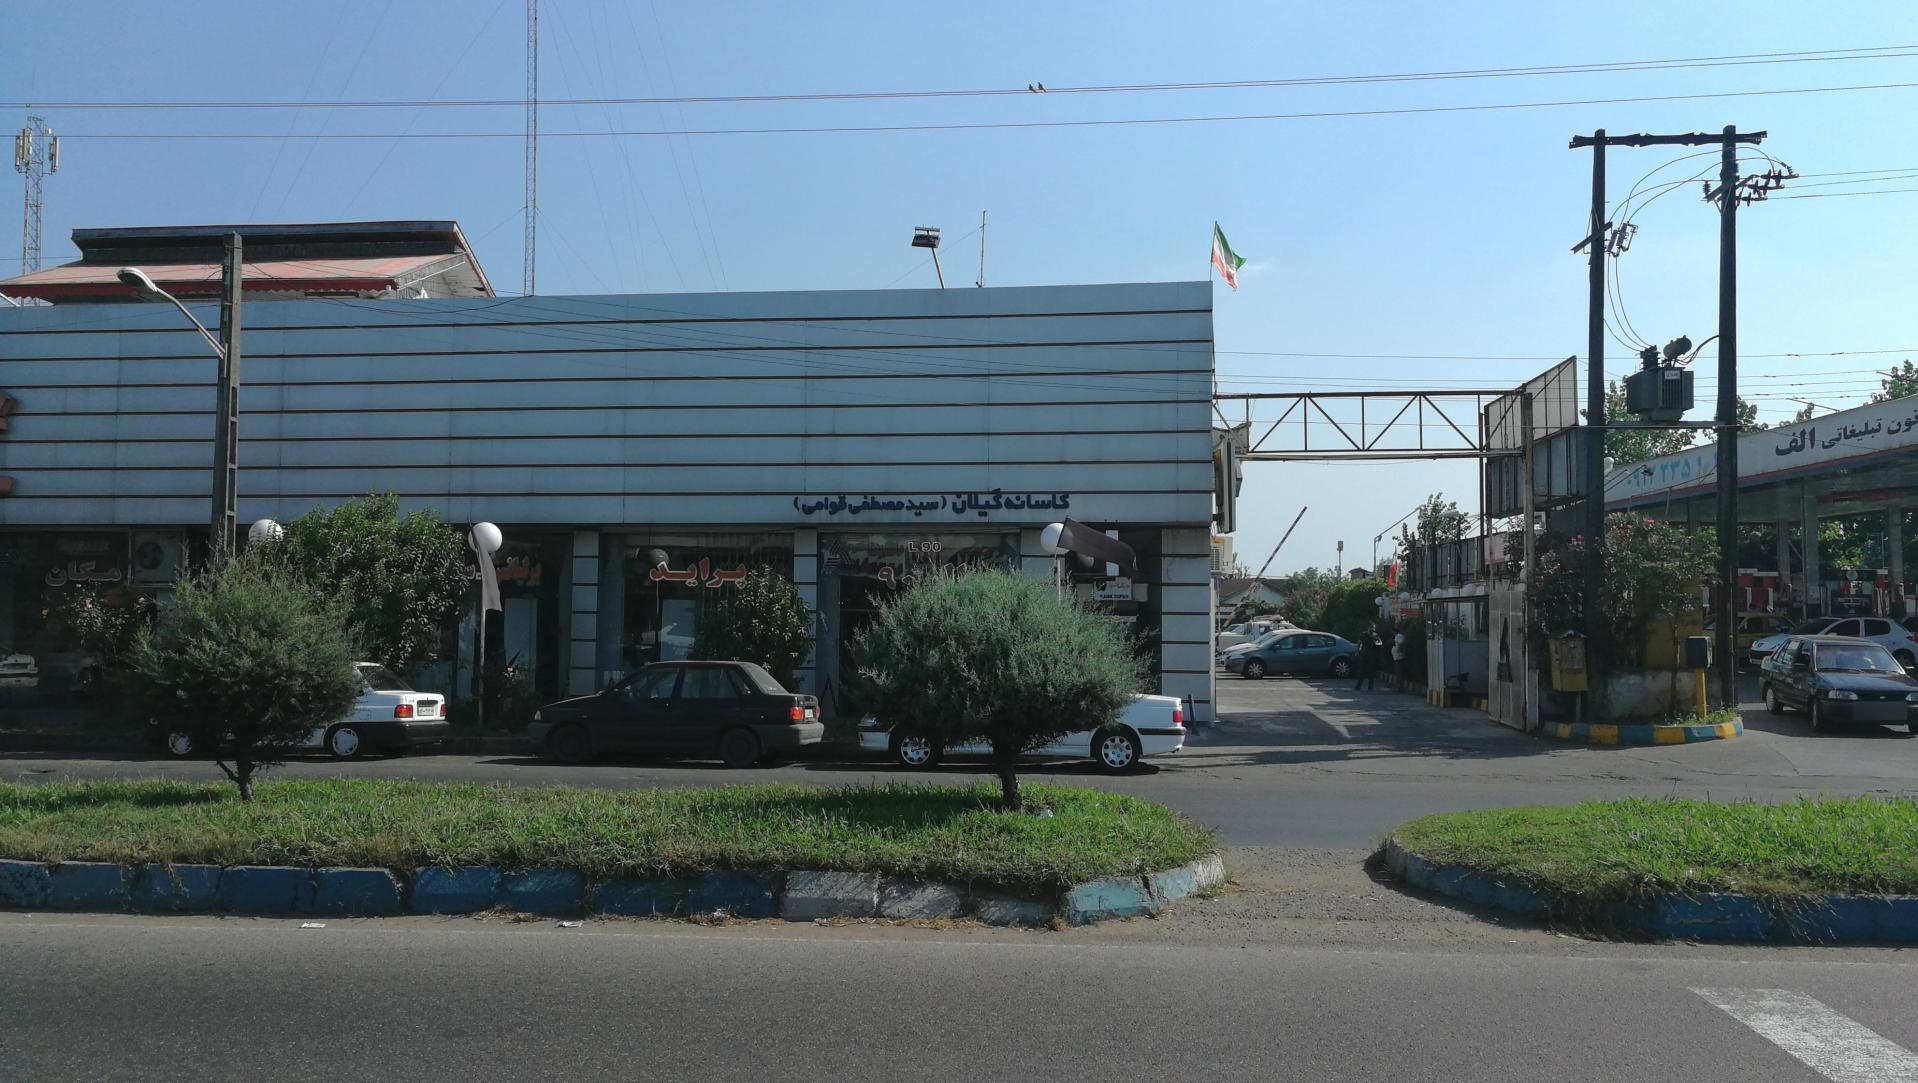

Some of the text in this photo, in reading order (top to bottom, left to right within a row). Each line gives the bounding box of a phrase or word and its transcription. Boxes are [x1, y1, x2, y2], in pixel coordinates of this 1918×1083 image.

[1775, 427, 1815, 456] الف
[1822, 418, 1882, 450] تبلیغاتی
[848, 495, 905, 515] مصطفی
[952, 488, 1003, 517] گیلان
[907, 541, 942, 552] L 90
[649, 556, 747, 589] پراید
